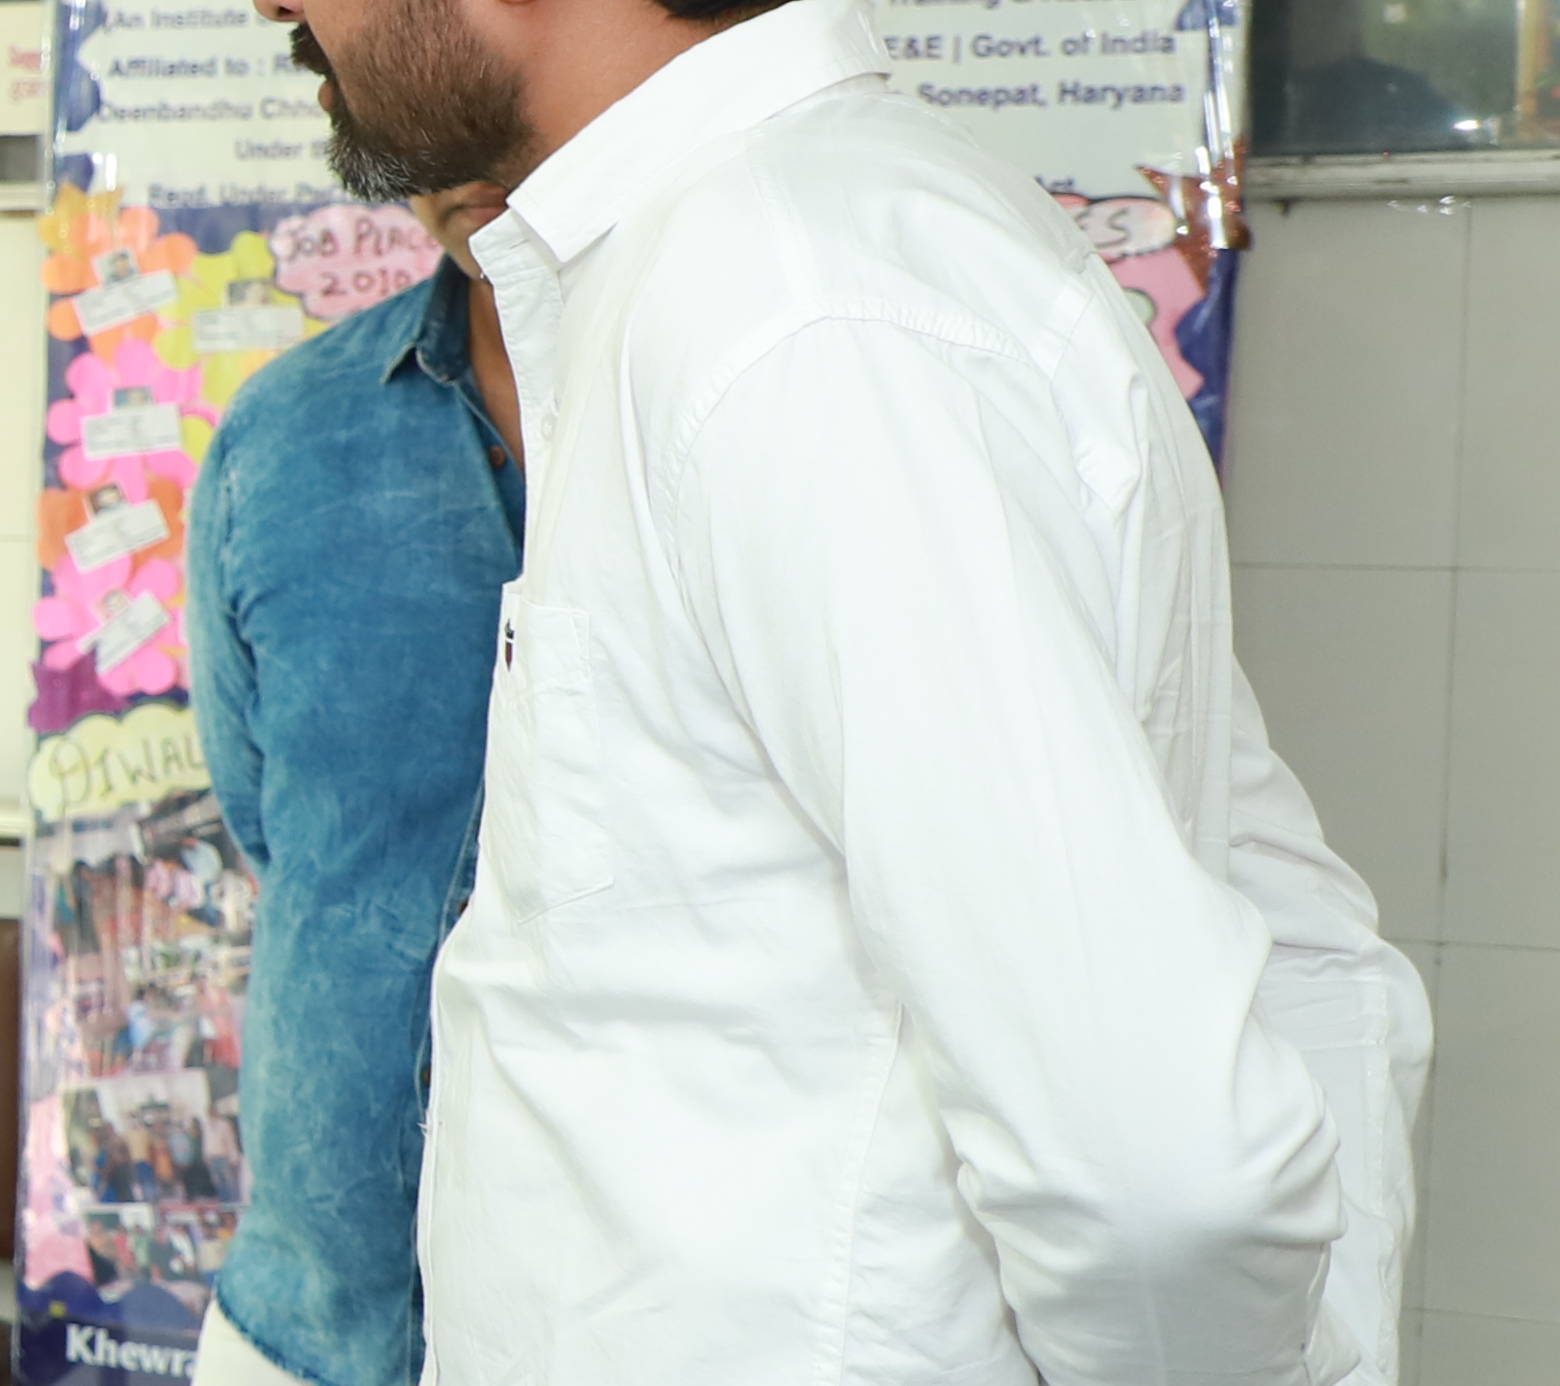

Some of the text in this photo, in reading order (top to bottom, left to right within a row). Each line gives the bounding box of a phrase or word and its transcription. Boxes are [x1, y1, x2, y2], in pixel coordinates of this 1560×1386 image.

[109, 54, 219, 78] Affiliated
[972, 34, 1052, 59] Govt.
[1062, 29, 1095, 56] of
[1100, 29, 1177, 55] India
[1057, 79, 1187, 111] Haryana
